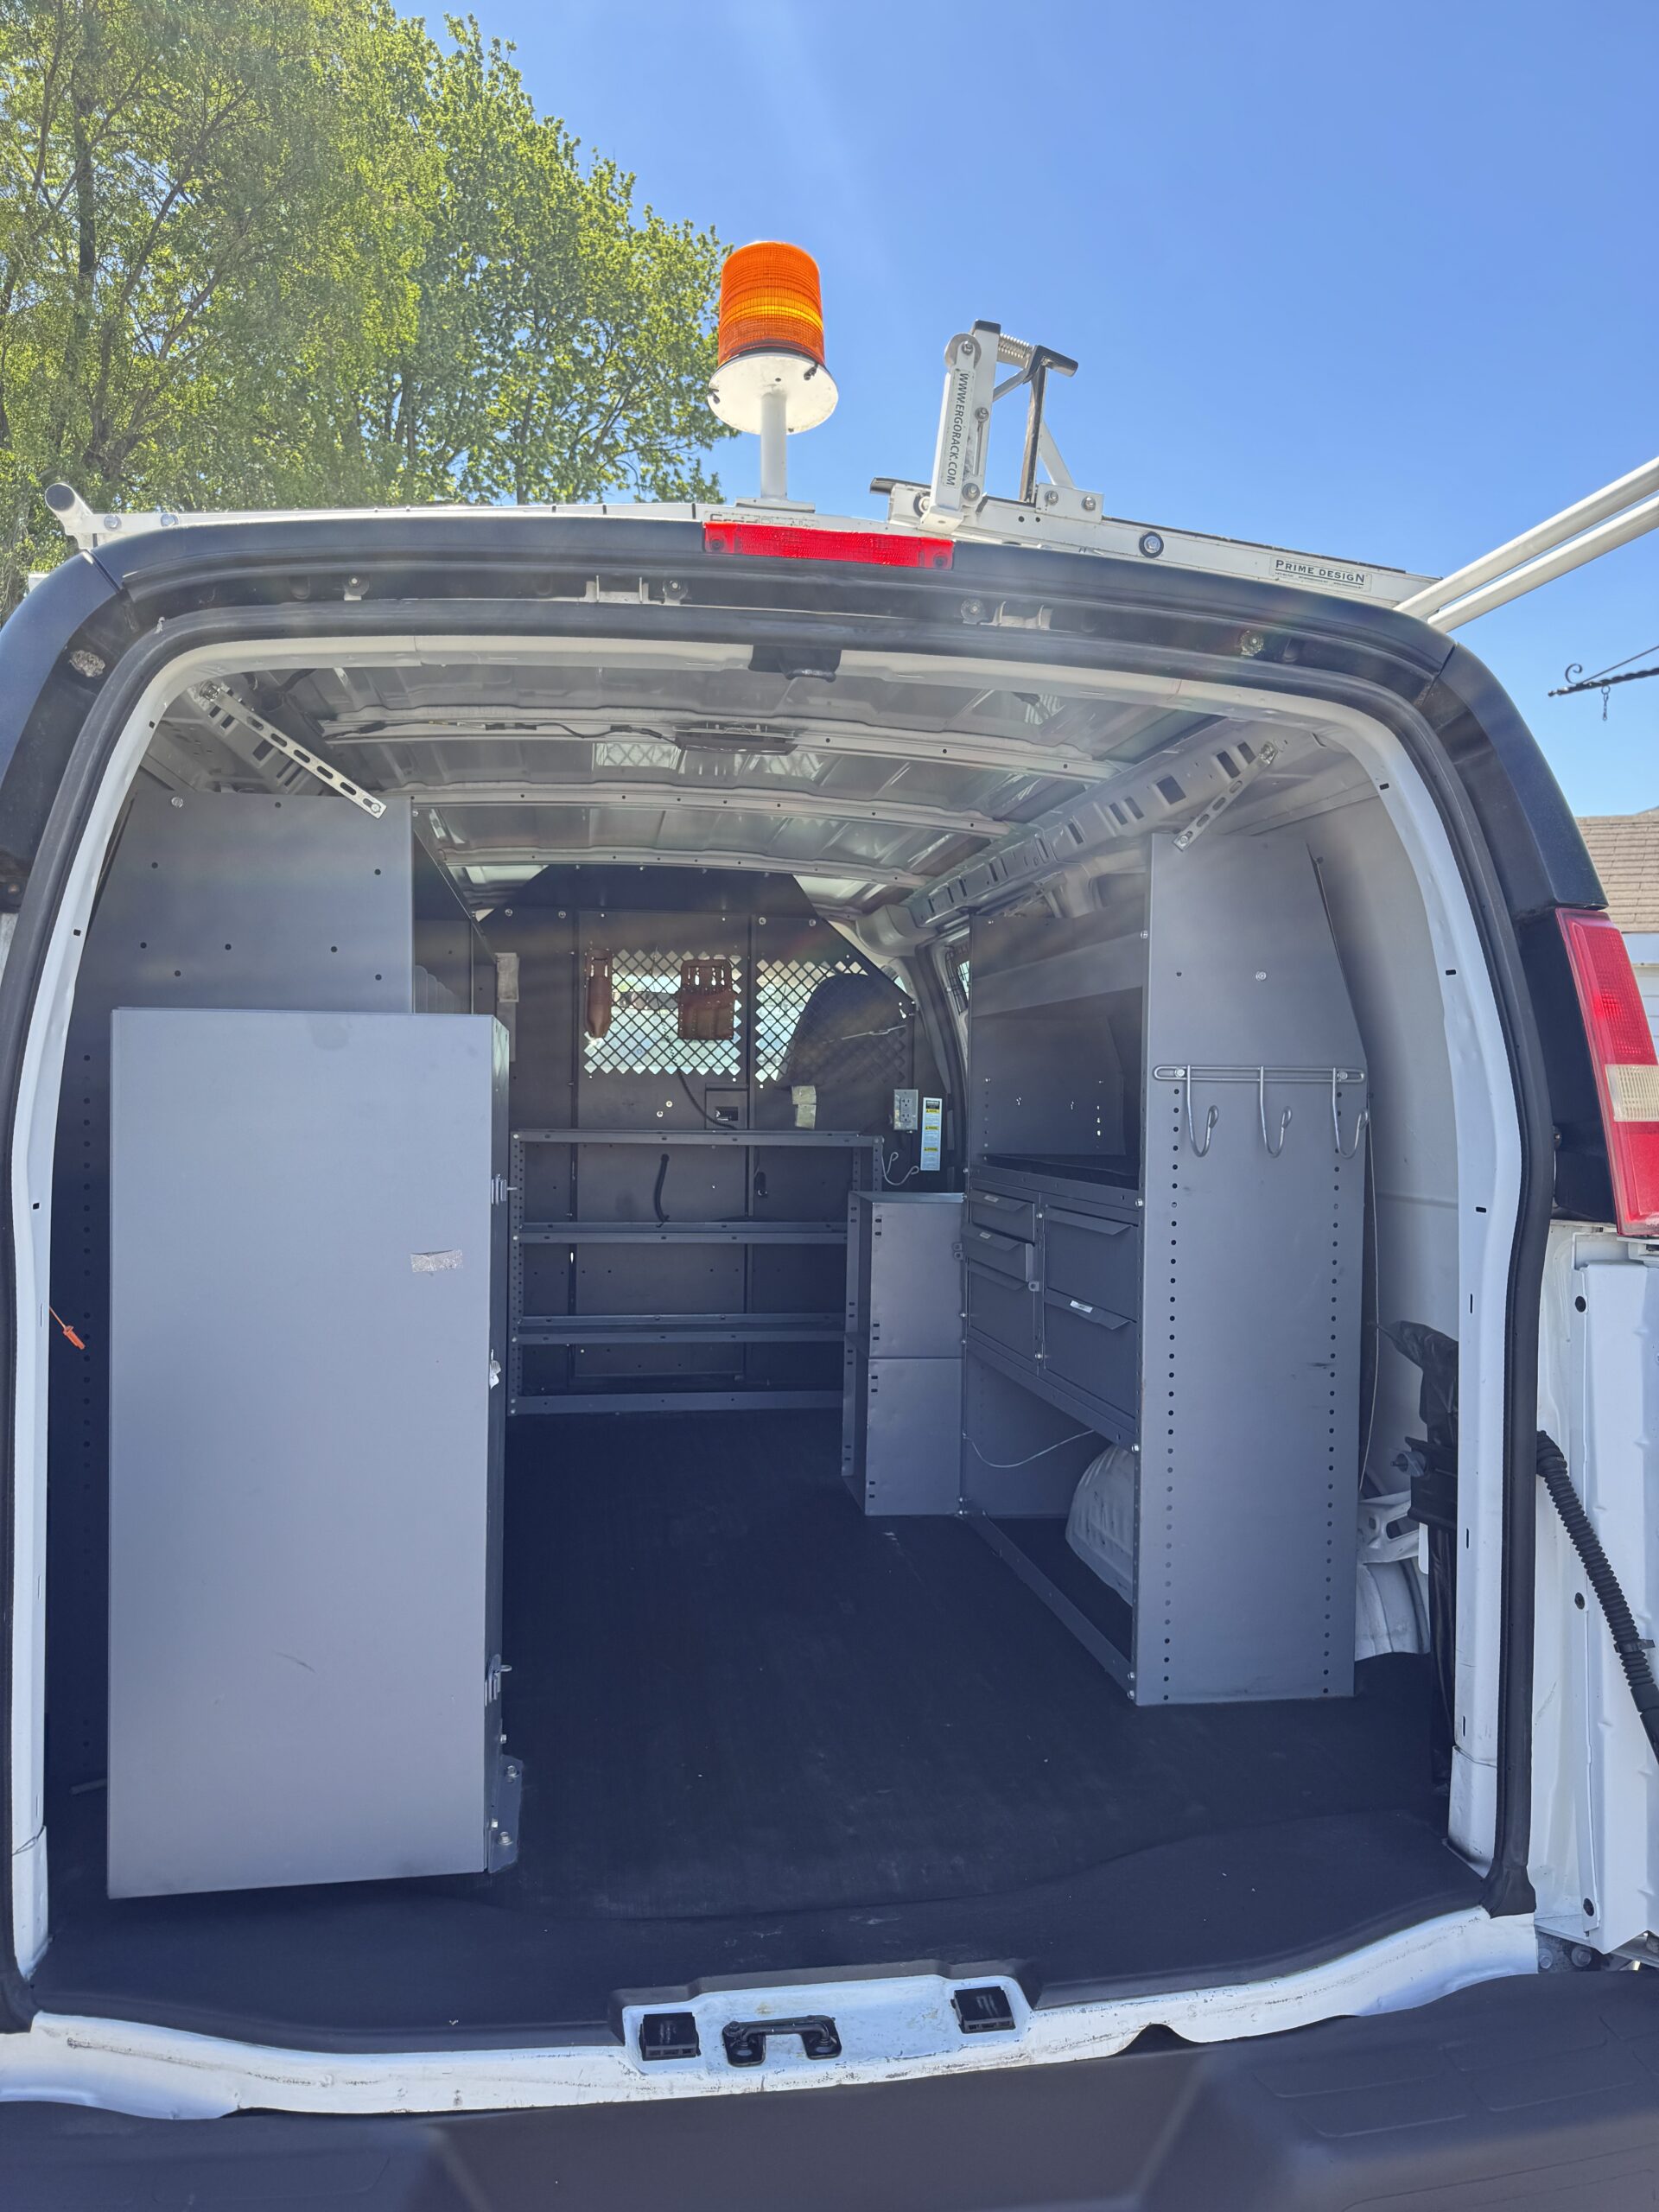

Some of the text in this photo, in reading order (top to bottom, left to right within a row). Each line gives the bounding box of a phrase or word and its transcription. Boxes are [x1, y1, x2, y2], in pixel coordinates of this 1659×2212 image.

[946, 372, 969, 486] WWW.ERGORACK.COM
[1275, 560, 1314, 574] PRIME
[1319, 569, 1365, 583] DESIGN
